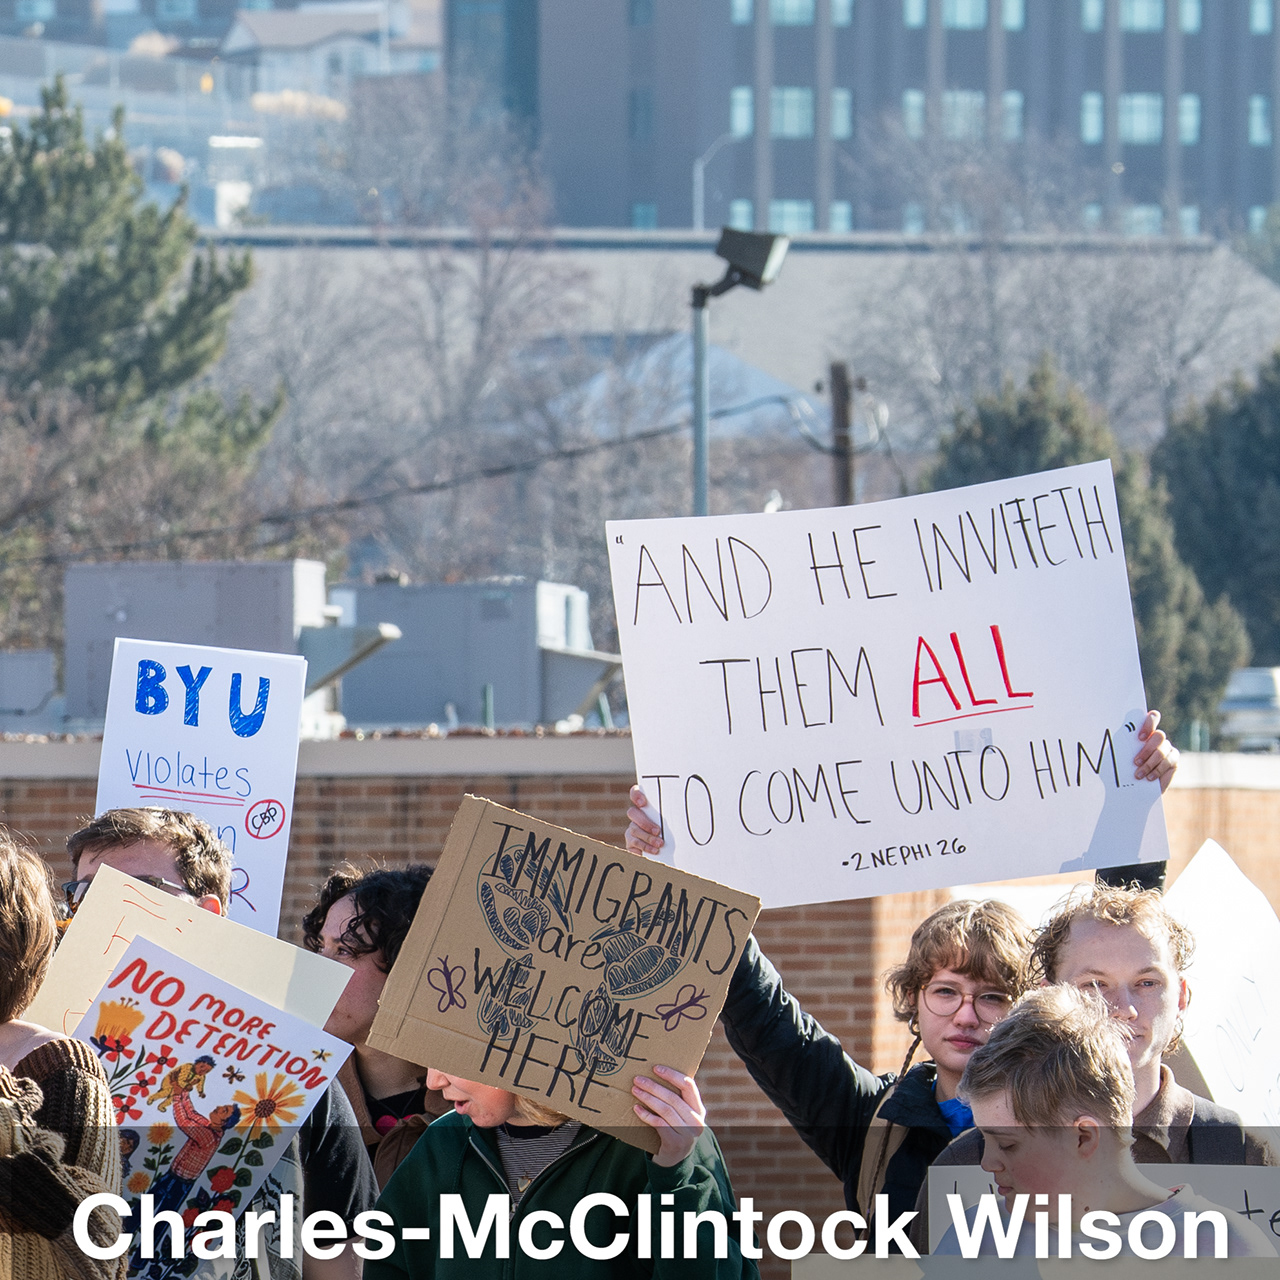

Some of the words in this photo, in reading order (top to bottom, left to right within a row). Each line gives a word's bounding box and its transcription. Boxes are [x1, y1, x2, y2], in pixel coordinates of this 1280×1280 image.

[615, 535, 772, 626] "AND
[808, 525, 898, 605] HE
[135, 659, 271, 738] BYU
[699, 646, 884, 735] THEM
[911, 624, 1034, 718] ALL
[251, 806, 278, 830] CBP
[641, 773, 715, 846] TO
[739, 760, 872, 836] COME
[891, 744, 1011, 815] UNTO
[871, 842, 931, 868] NEPHI
[936, 837, 966, 857] 26
[482, 821, 748, 975] IMMIGRANTS
[537, 926, 606, 970] are
[107, 957, 185, 1008] NO
[189, 993, 277, 1040] MORE
[473, 948, 663, 1062] WELCOME
[145, 1011, 328, 1090] DETENTION
[480, 1021, 609, 1113] HERE
